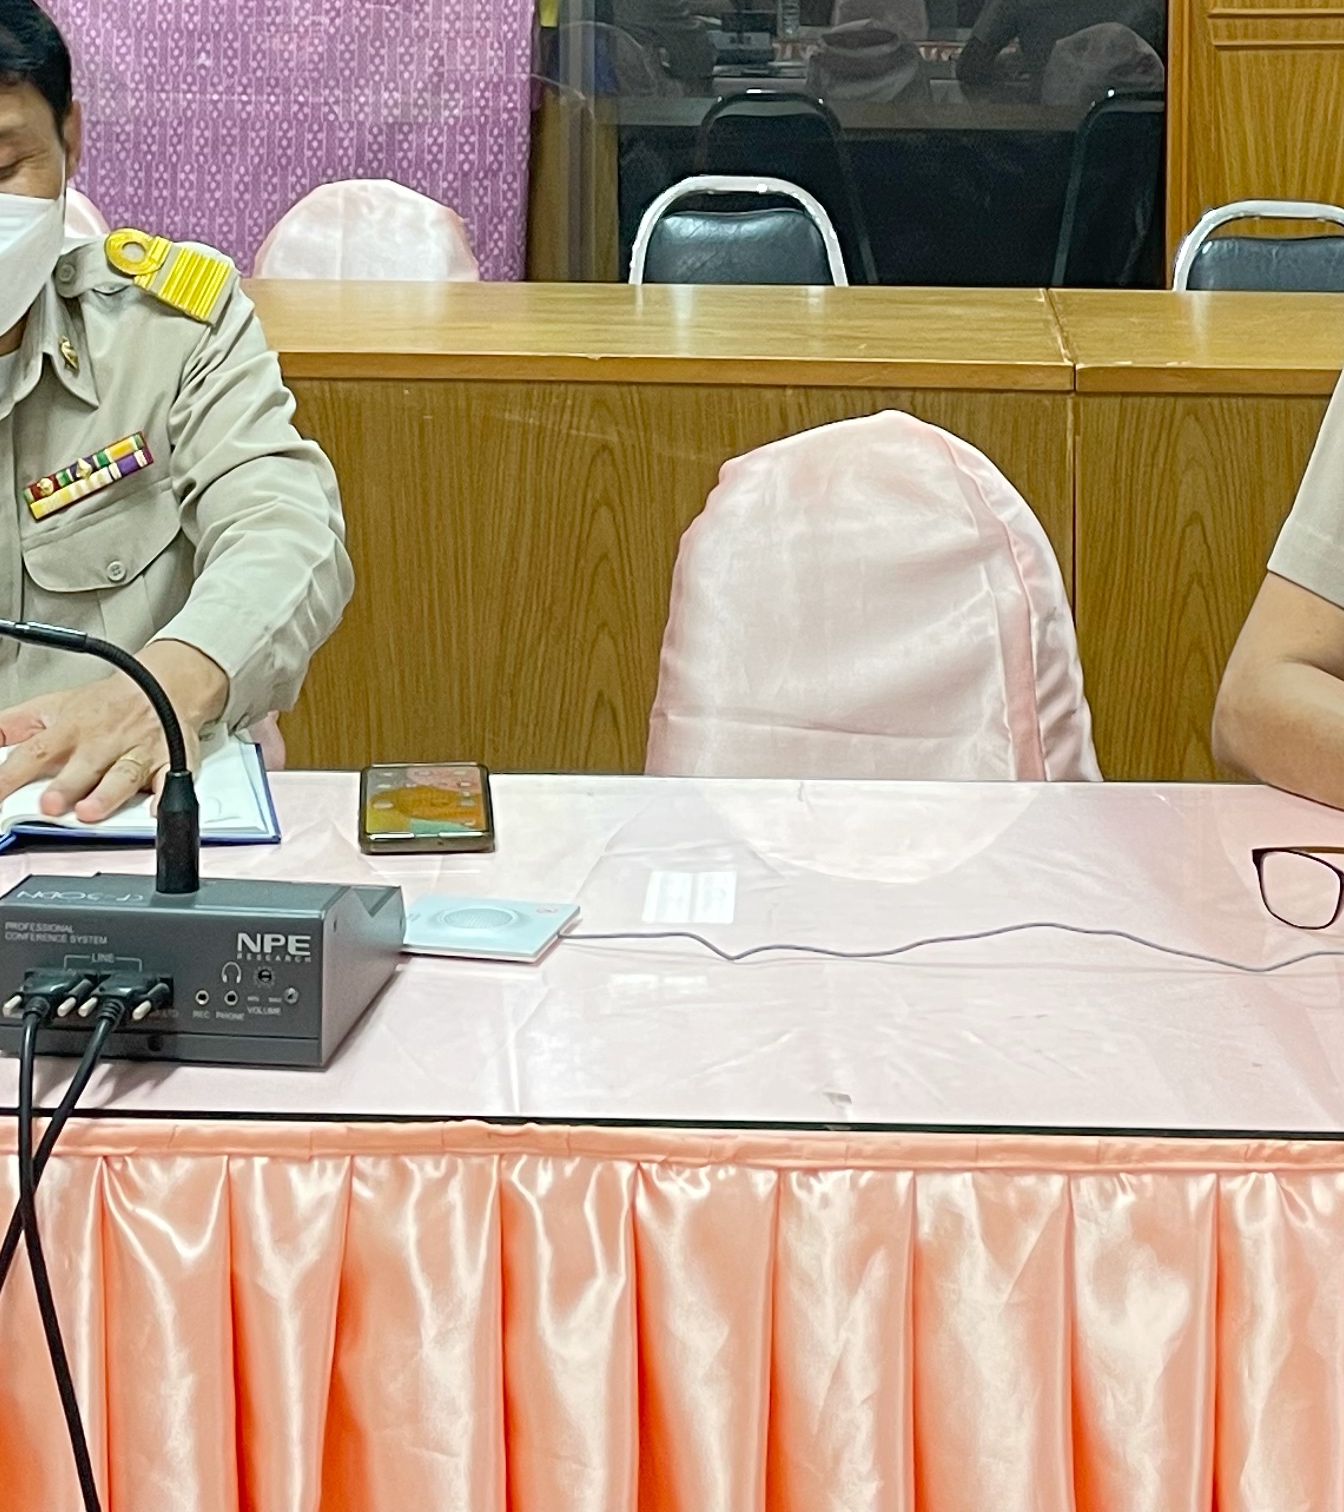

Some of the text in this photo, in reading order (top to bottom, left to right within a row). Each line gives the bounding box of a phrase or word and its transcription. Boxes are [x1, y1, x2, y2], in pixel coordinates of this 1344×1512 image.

[4, 922, 74, 933] PROFESSIONAL
[4, 932, 109, 945] CONFERENCE SYSTEM
[237, 932, 312, 956] NPE
[91, 953, 114, 963] LINE
[192, 1010, 244, 1021] REC PHONE
